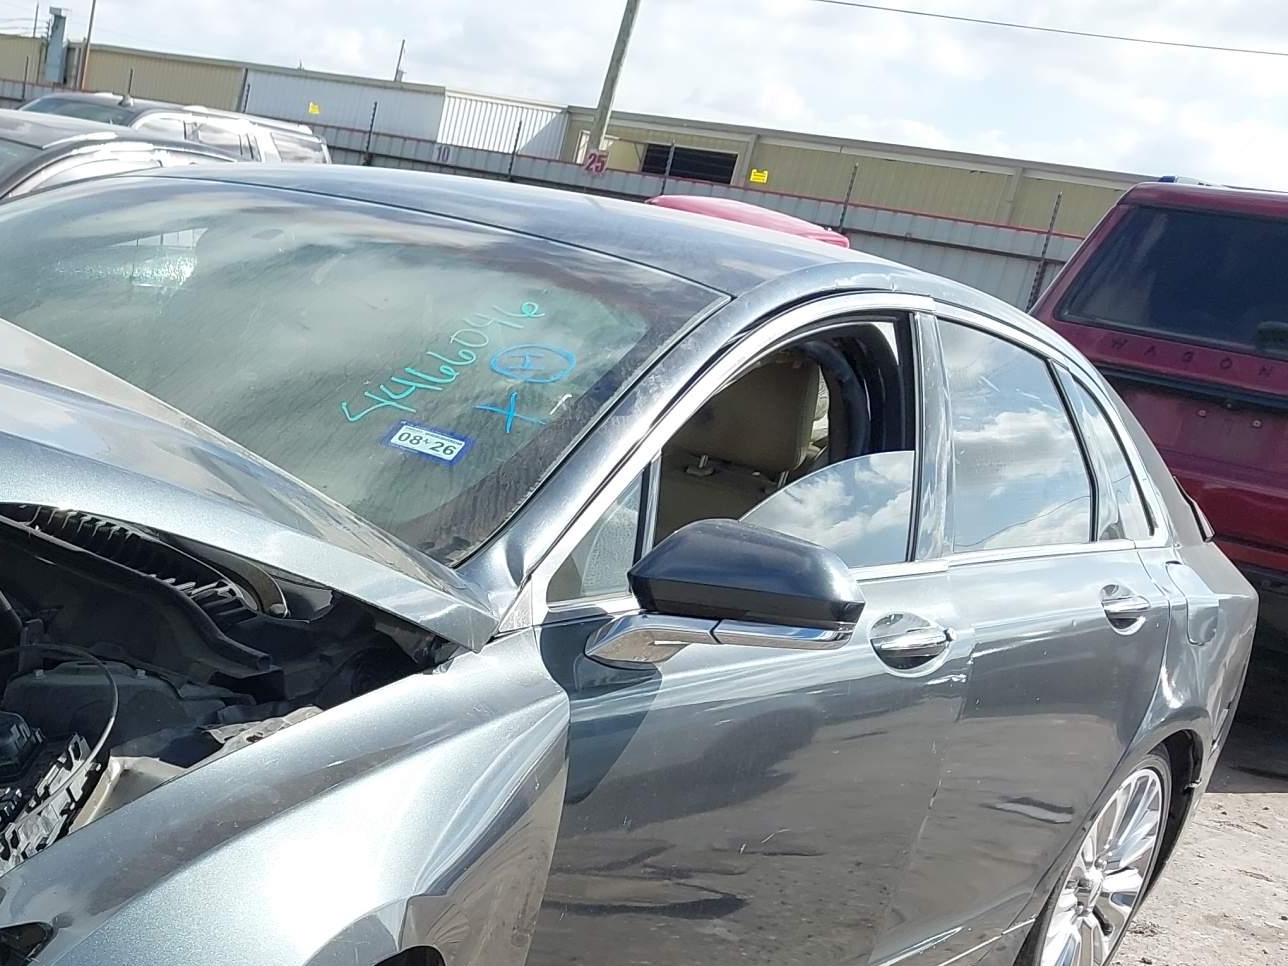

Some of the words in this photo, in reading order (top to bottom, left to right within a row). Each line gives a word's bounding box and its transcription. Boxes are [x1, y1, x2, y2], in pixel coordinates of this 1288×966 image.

[584, 152, 606, 173] 25
[397, 431, 423, 446] 08
[429, 440, 457, 456] 26
